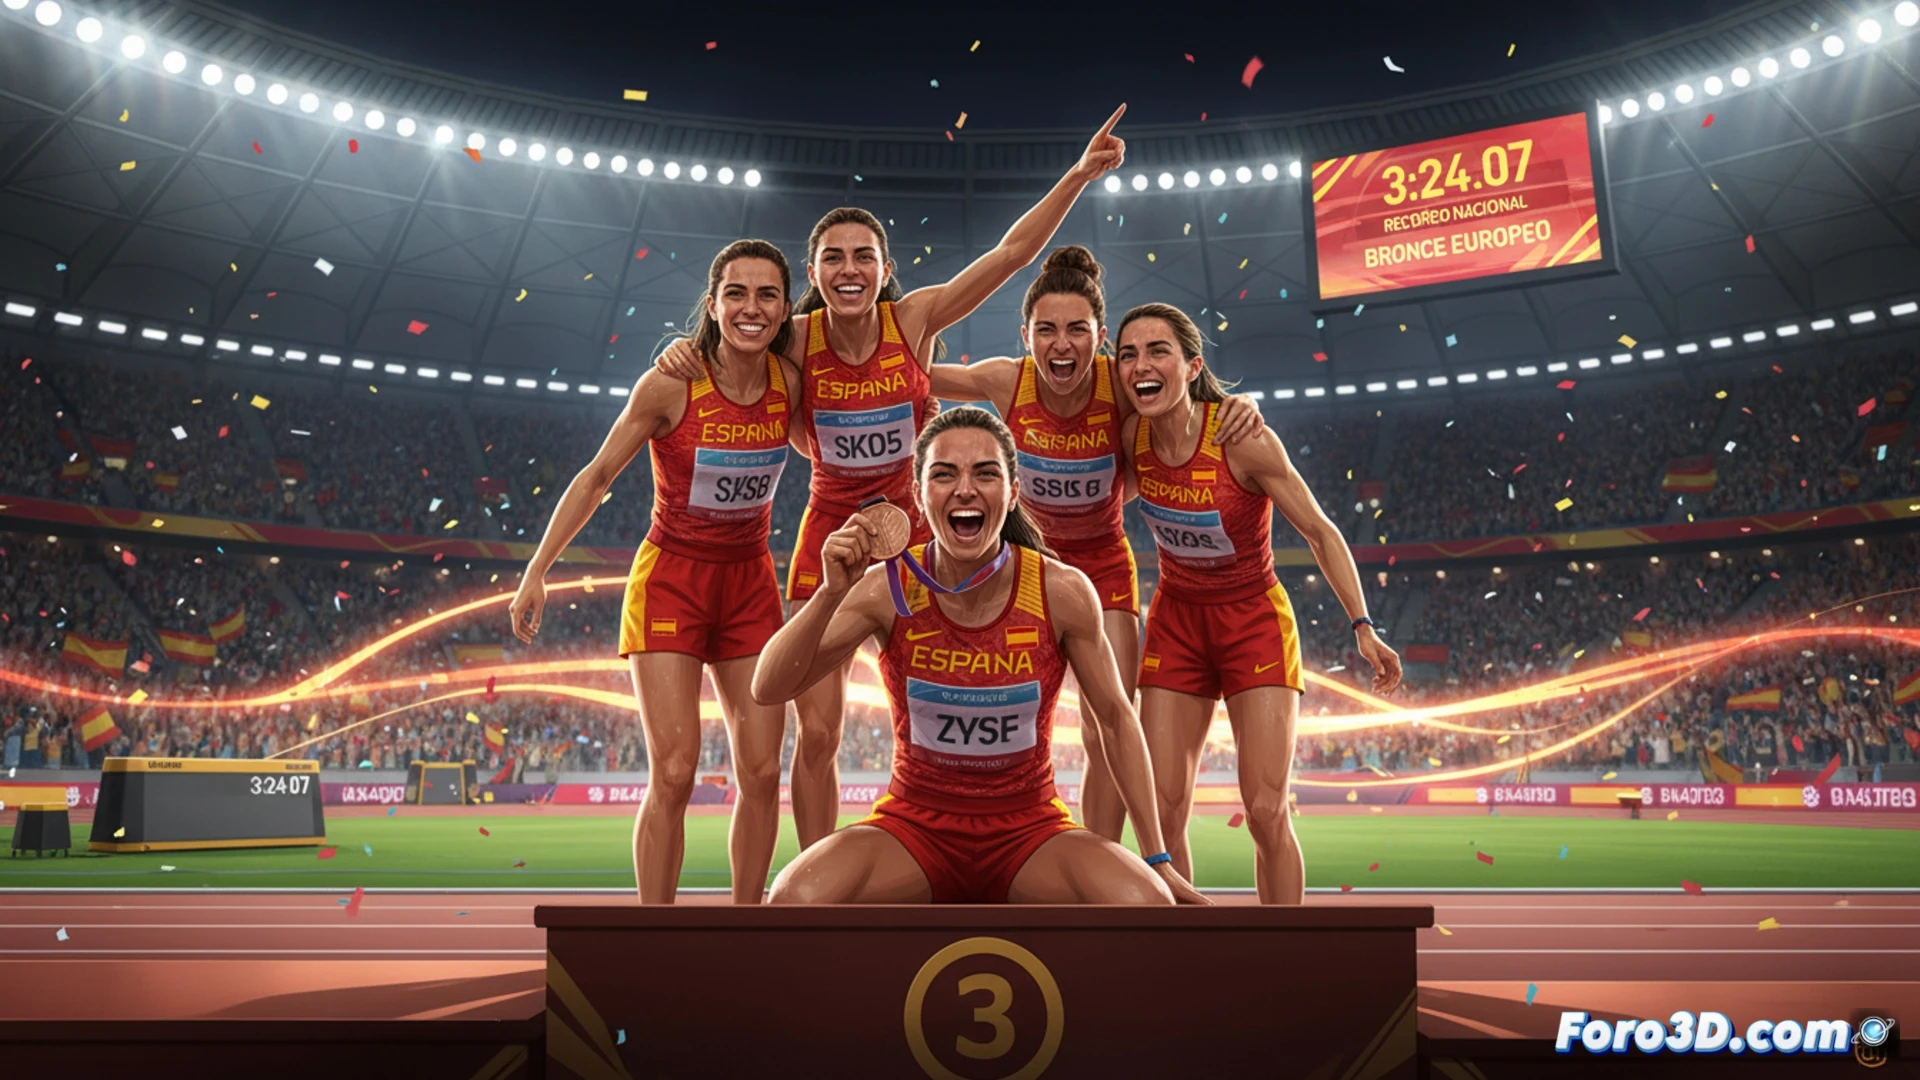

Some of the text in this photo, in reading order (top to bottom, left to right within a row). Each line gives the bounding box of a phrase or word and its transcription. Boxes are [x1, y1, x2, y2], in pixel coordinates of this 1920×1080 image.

[1381, 138, 1534, 206] 3:24.07
[1452, 195, 1529, 221] NACIONAL
[1364, 219, 1551, 269] BRONCE EUROPEO
[955, 972, 1016, 1060] 3
